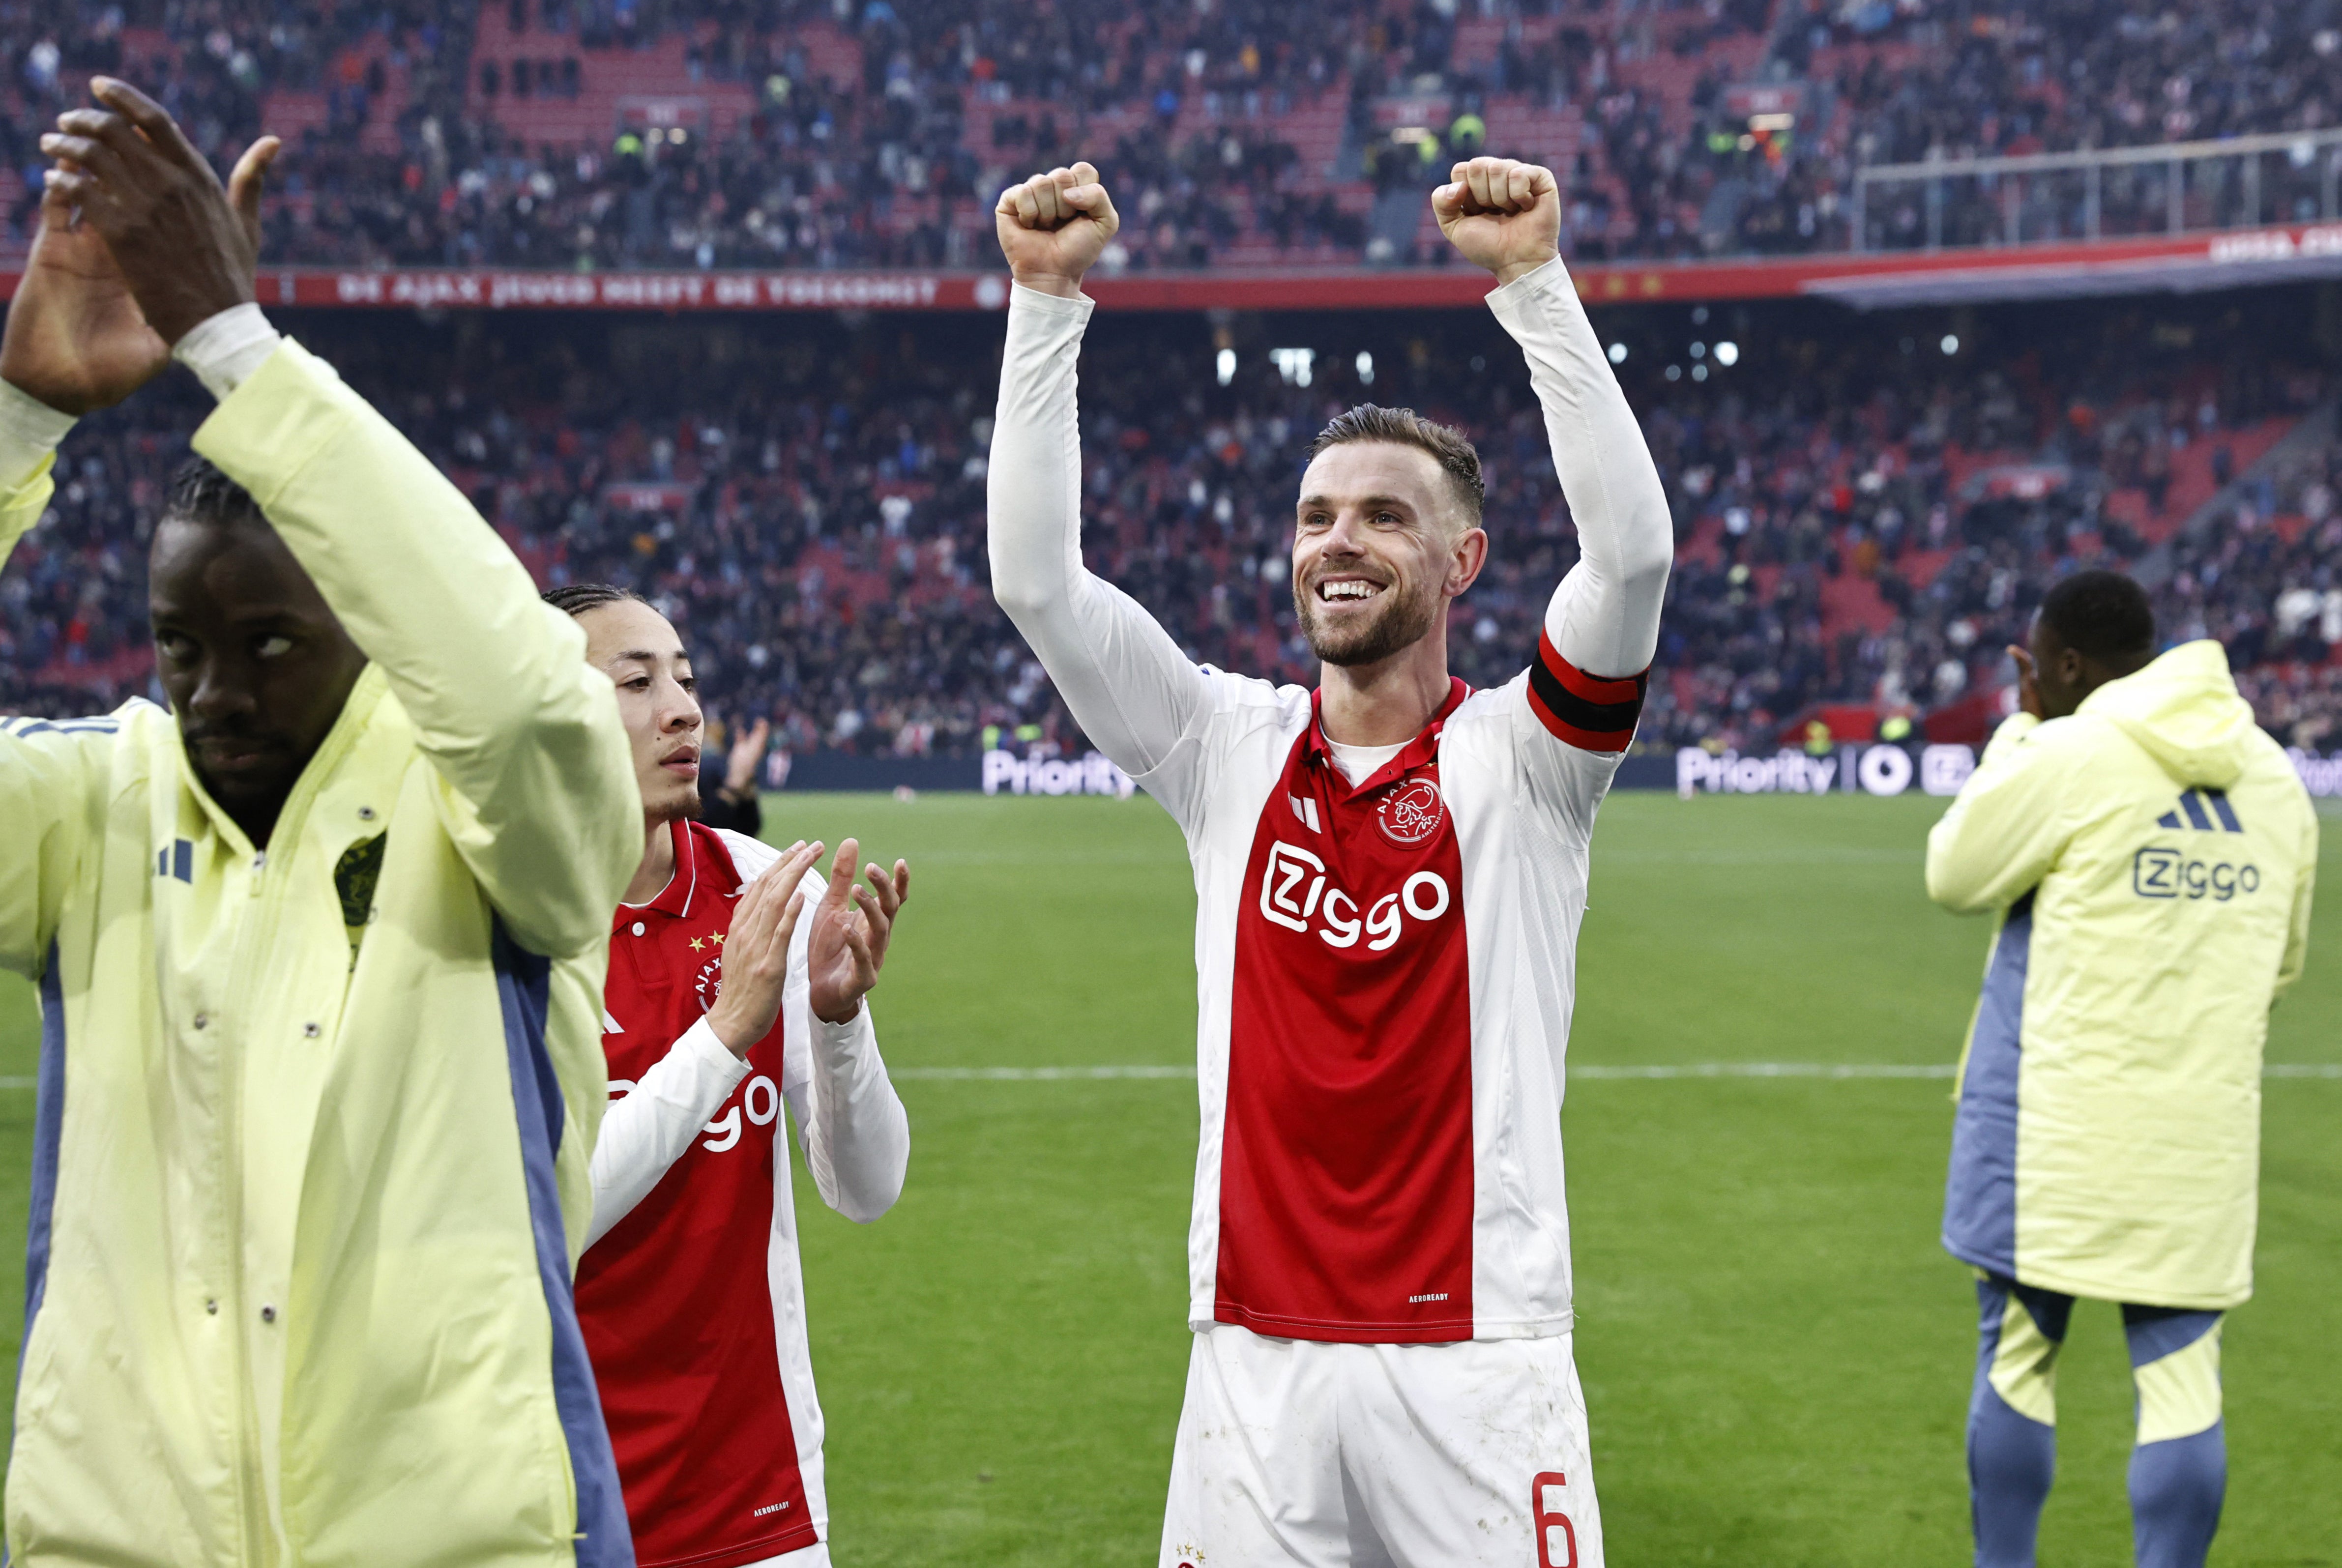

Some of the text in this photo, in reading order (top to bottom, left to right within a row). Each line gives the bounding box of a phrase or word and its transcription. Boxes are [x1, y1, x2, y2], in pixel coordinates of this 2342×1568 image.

[338, 273, 384, 303] DE
[393, 273, 481, 308] AJAX
[714, 273, 757, 305] DE
[1677, 747, 1838, 795] Priority
[1377, 780, 1408, 814] AJAX
[1421, 808, 1444, 839] AMSTERDAM
[1260, 840, 1449, 951] Ziggo
[695, 958, 722, 993] AJAX
[1409, 1293, 1448, 1303] AEROREADY
[754, 1501, 789, 1517] AEROREADY
[1532, 1471, 1578, 1568] 6
